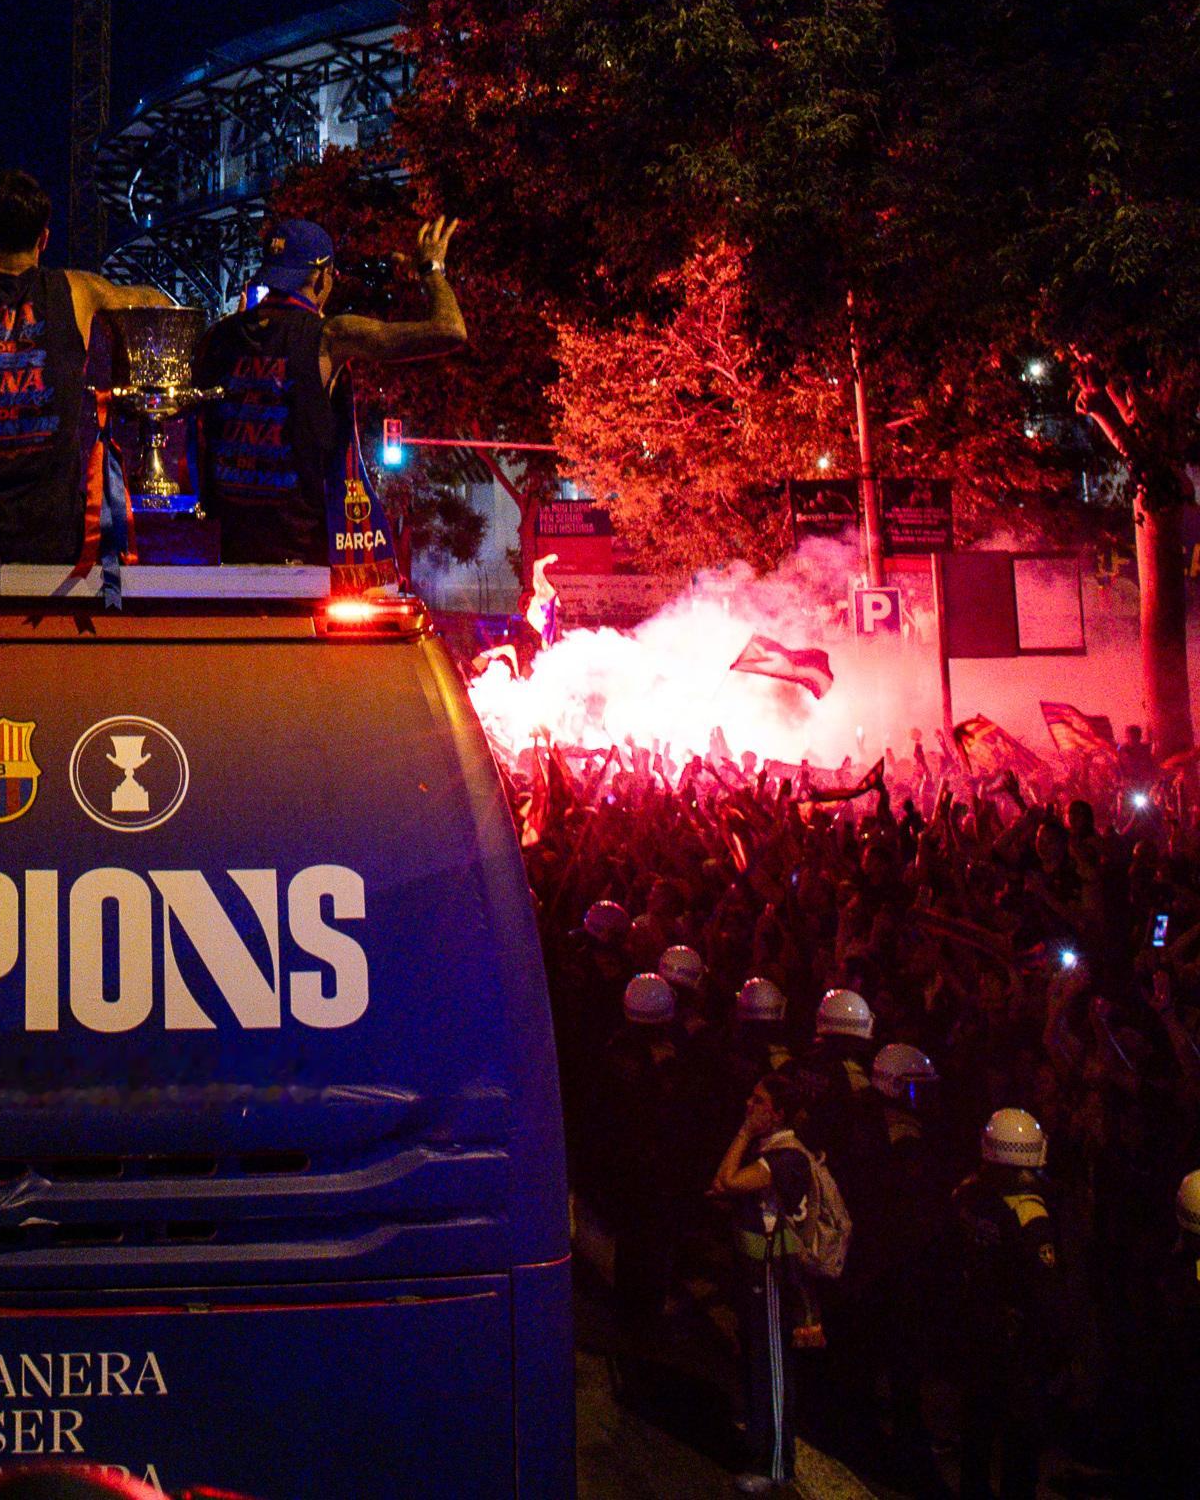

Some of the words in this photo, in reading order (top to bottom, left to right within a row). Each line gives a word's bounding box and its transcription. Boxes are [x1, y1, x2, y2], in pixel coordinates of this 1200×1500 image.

[224, 419, 284, 448] UNA
[335, 529, 387, 552] BARÇA
[863, 592, 892, 633] P
